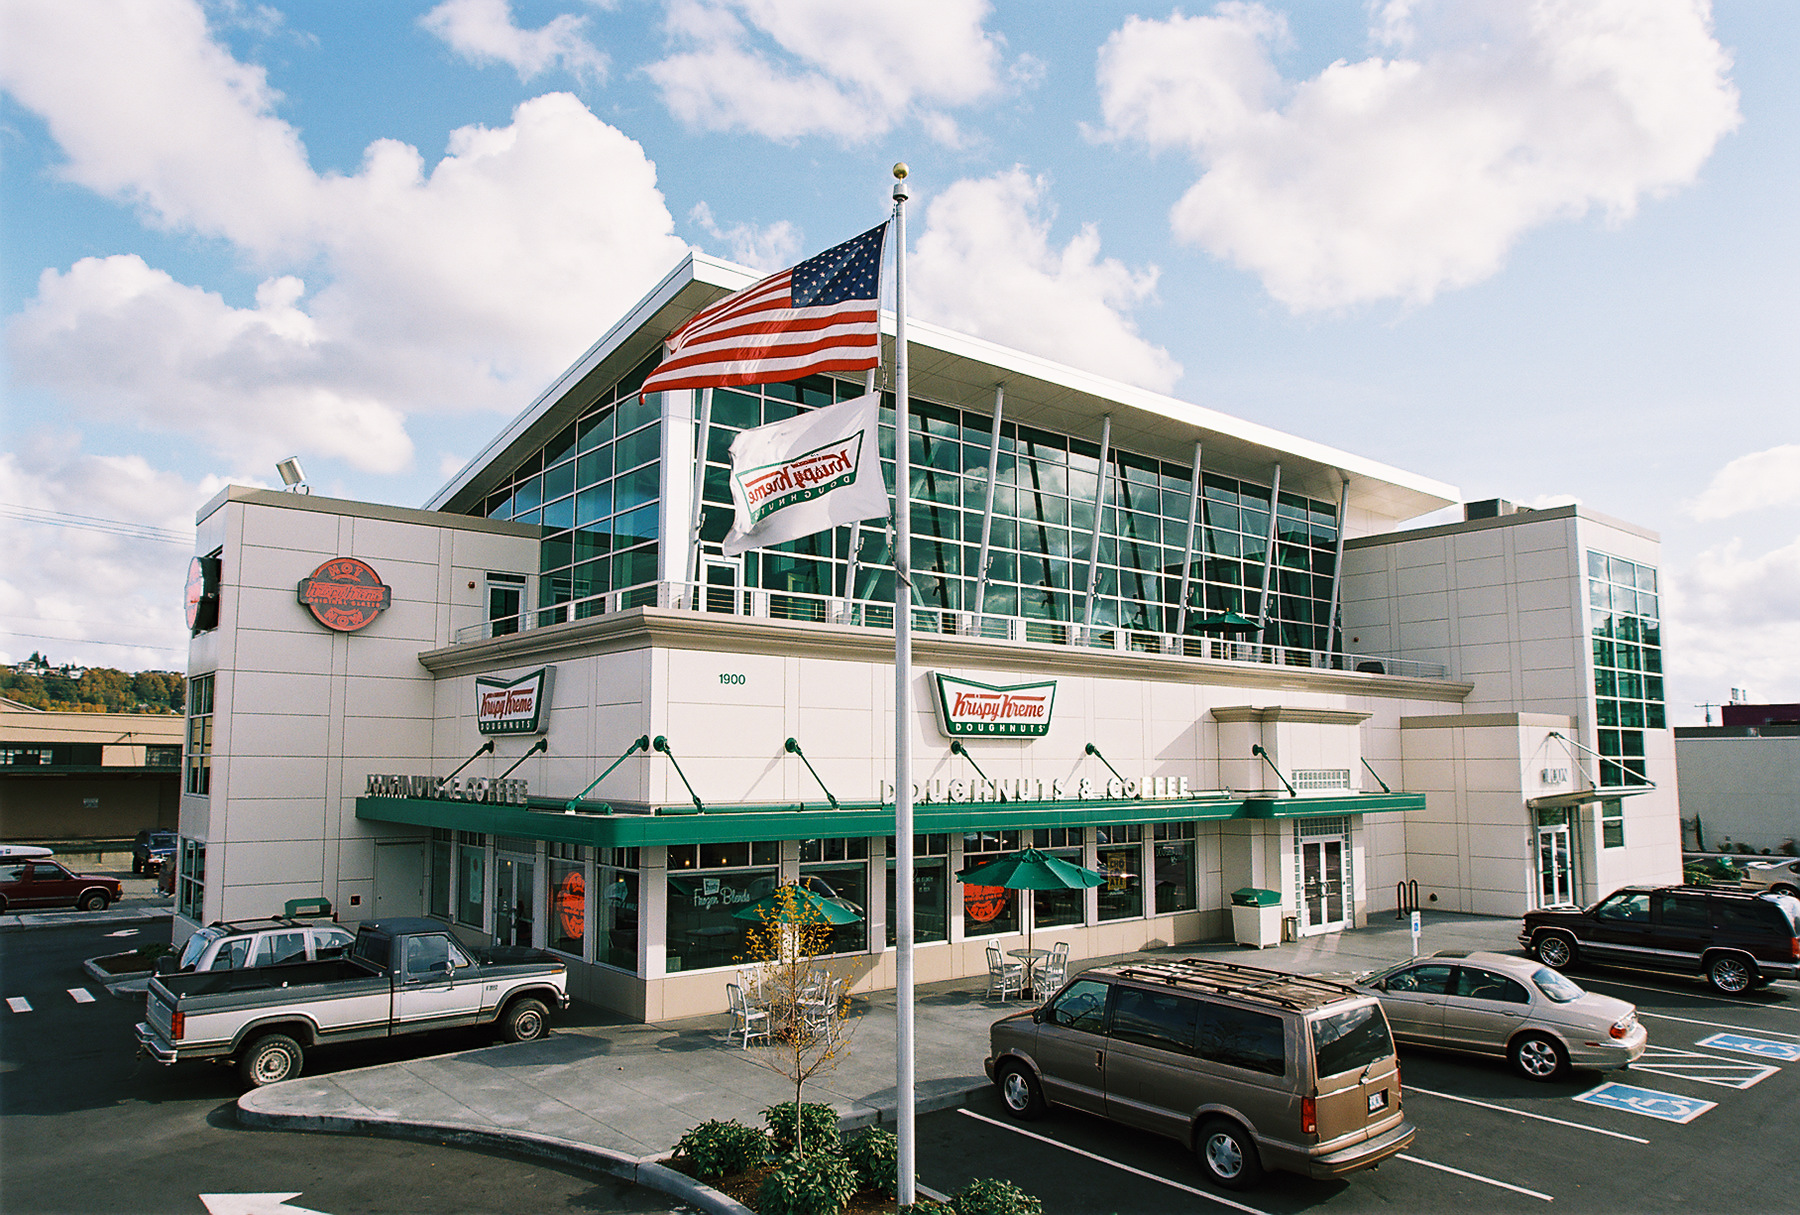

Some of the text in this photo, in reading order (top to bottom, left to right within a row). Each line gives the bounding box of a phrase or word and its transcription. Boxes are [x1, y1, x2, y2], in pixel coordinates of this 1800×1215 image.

[328, 563, 363, 577] HOT
[324, 611, 363, 625] NOW
[718, 673, 746, 685] 1900
[480, 687, 534, 719] Krispy Kreme
[952, 692, 1046, 721] Krispy Kreme
[480, 720, 530, 731] DOUGHNUTS
[955, 724, 1044, 732] DOUGHNUTS
[466, 777, 528, 804] COFFEE
[1079, 778, 1093, 799] &
[1107, 776, 1188, 799] COFFEE
